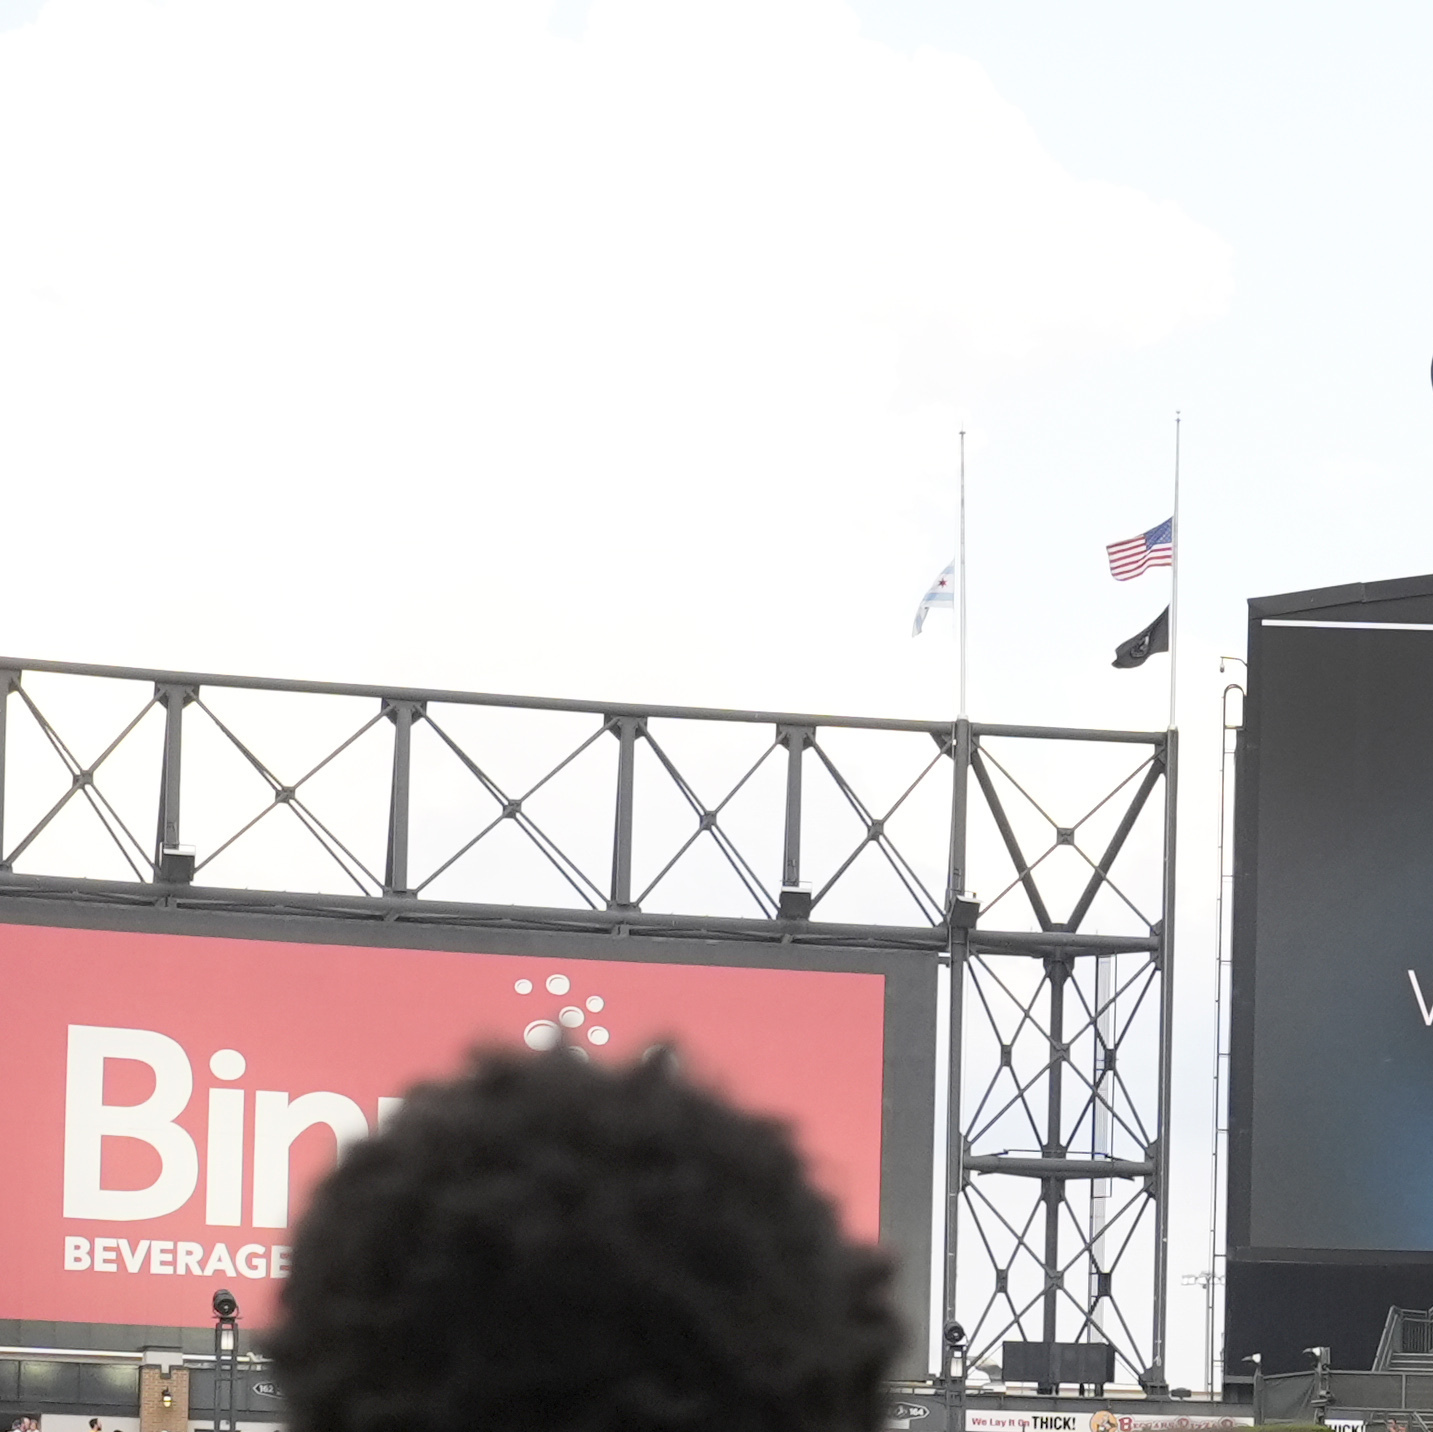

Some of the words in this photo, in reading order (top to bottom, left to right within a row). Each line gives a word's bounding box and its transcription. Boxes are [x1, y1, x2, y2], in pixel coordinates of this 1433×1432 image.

[63, 1024, 406, 1228] Bin
[972, 1418, 987, 1426] We
[990, 1418, 1006, 1428] Lay
[1032, 1416, 1075, 1430] THICK!
